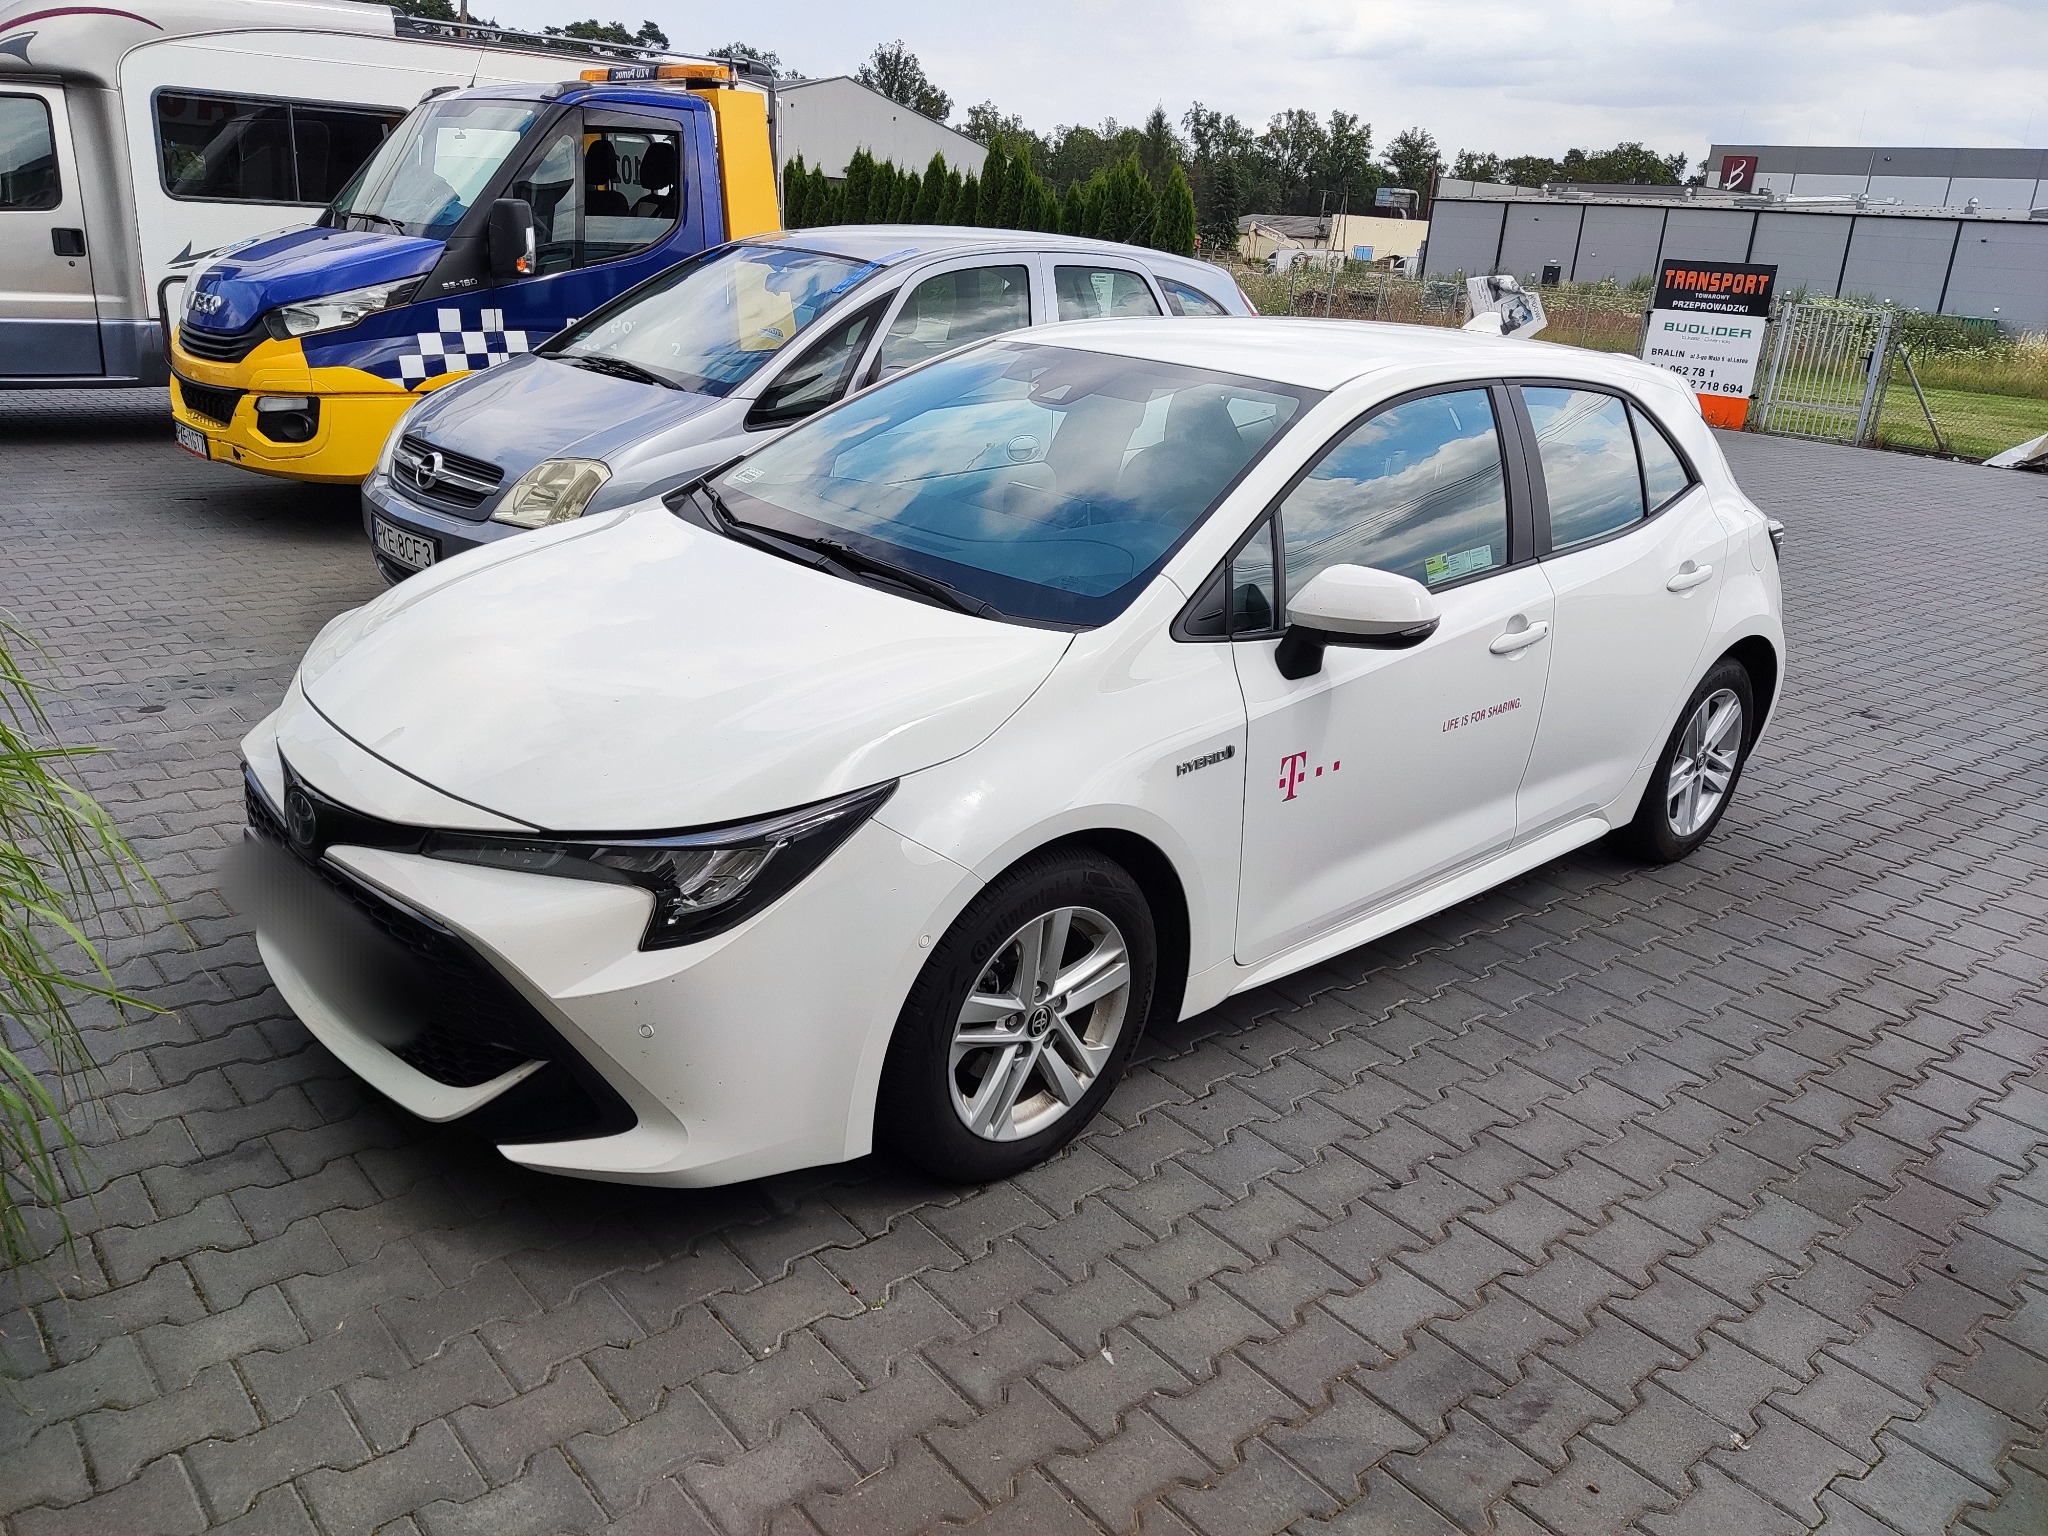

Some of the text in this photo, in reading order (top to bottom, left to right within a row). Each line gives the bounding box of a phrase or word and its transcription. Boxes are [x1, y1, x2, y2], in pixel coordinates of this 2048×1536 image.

[1665, 269, 1770, 296] TRANSPORT
[1695, 292, 1731, 301] TOWAROWY
[1672, 300, 1749, 313] PRZEPROWADZKI
[1651, 348, 1686, 359] BRALIN
[1692, 367, 1706, 377] 78
[1699, 380, 1720, 392] 718
[1722, 383, 1744, 394] 694
[1442, 697, 1522, 733] LIFE IS FOR SHARING.
